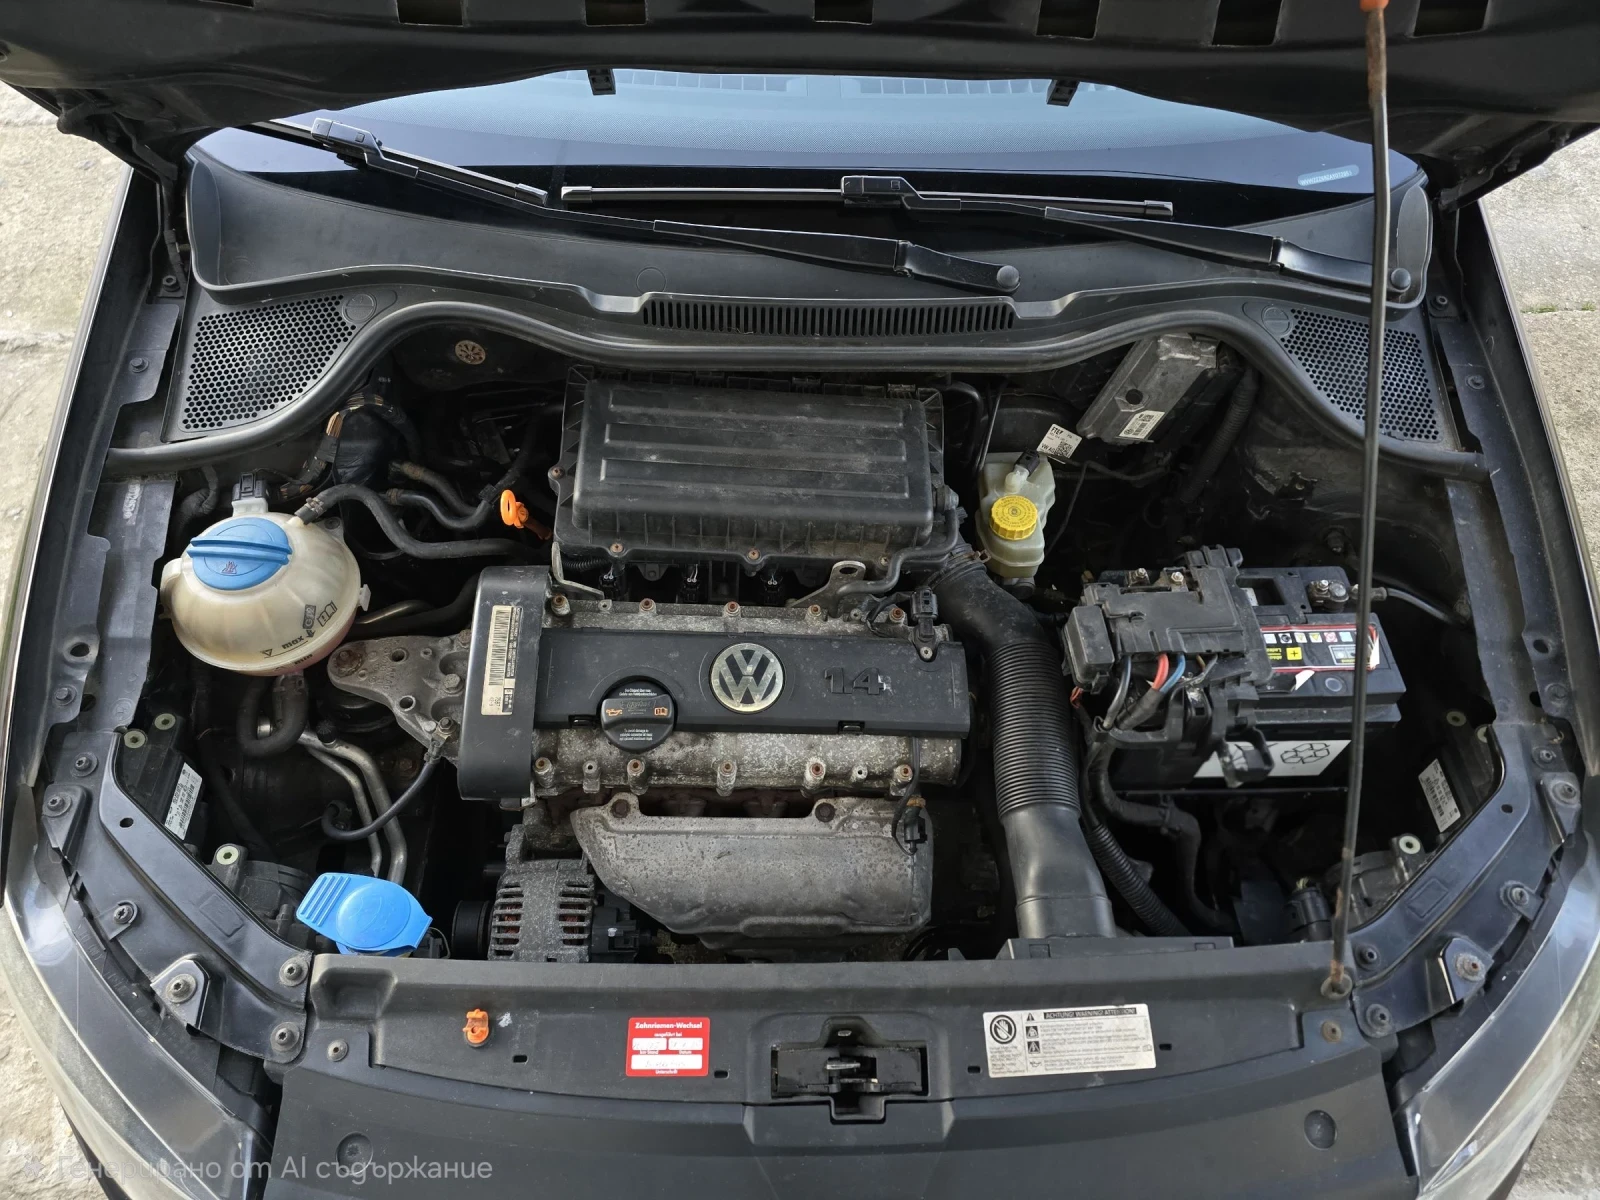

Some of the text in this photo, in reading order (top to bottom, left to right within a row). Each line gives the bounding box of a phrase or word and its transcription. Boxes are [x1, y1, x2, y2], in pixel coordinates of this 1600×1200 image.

[281, 635, 304, 649] max
[294, 653, 313, 665] min
[714, 644, 781, 710] VW
[824, 667, 886, 696] 1.4
[1045, 1011, 1074, 1019] ACHTUNG!
[635, 1021, 703, 1029] Zahnriemen-Wechsel
